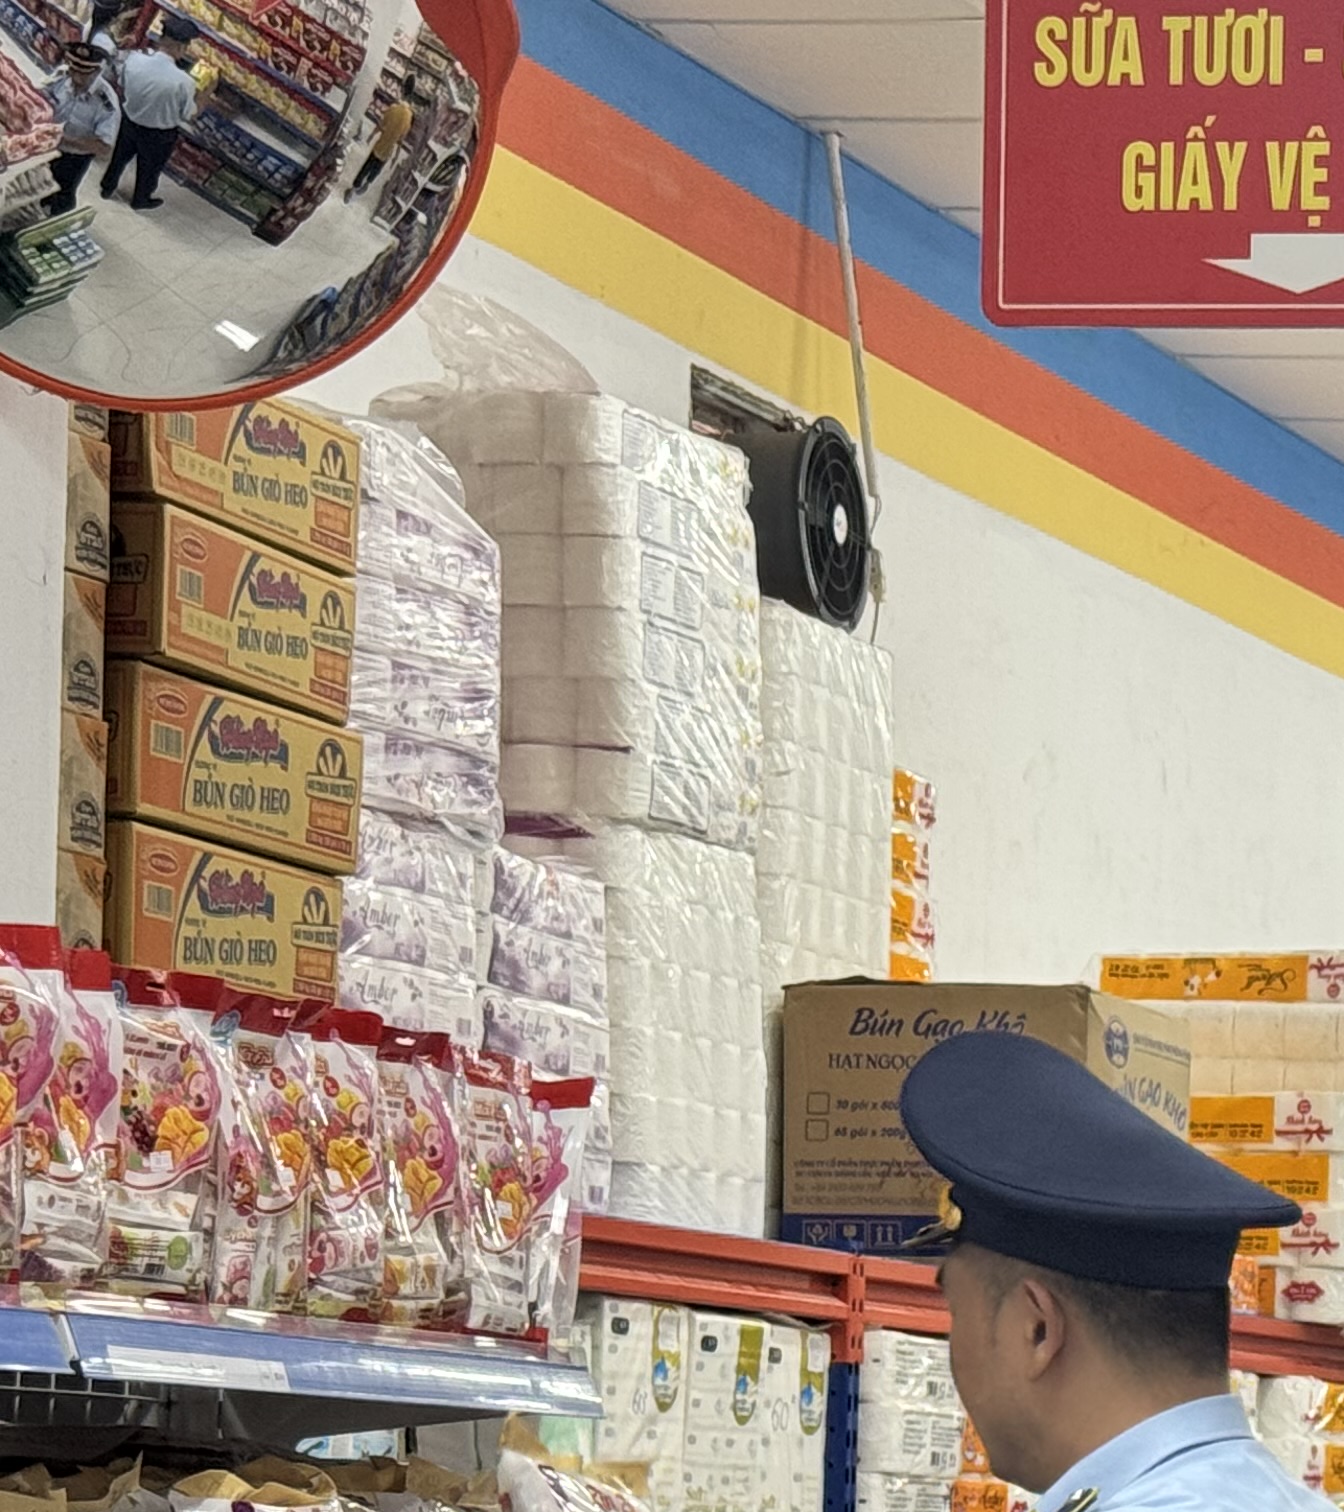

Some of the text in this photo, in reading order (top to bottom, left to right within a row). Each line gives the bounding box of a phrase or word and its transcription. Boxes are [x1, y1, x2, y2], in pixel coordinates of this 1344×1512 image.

[1034, 3, 1144, 87] SỮA
[1162, 14, 1284, 86] TƯƠI
[1304, 48, 1325, 62] -
[1122, 114, 1249, 212] GIẤY
[1265, 125, 1331, 228] VỆ
[284, 479, 309, 510] HEO
[285, 634, 309, 660] HEO
[230, 778, 255, 811] GIÒ
[259, 788, 291, 815] HEO
[219, 932, 243, 966] GIÒ
[247, 939, 278, 967] HEO
[849, 1007, 905, 1038] Bún
[913, 1009, 965, 1043] Gạo
[828, 1053, 863, 1072] HẠT
